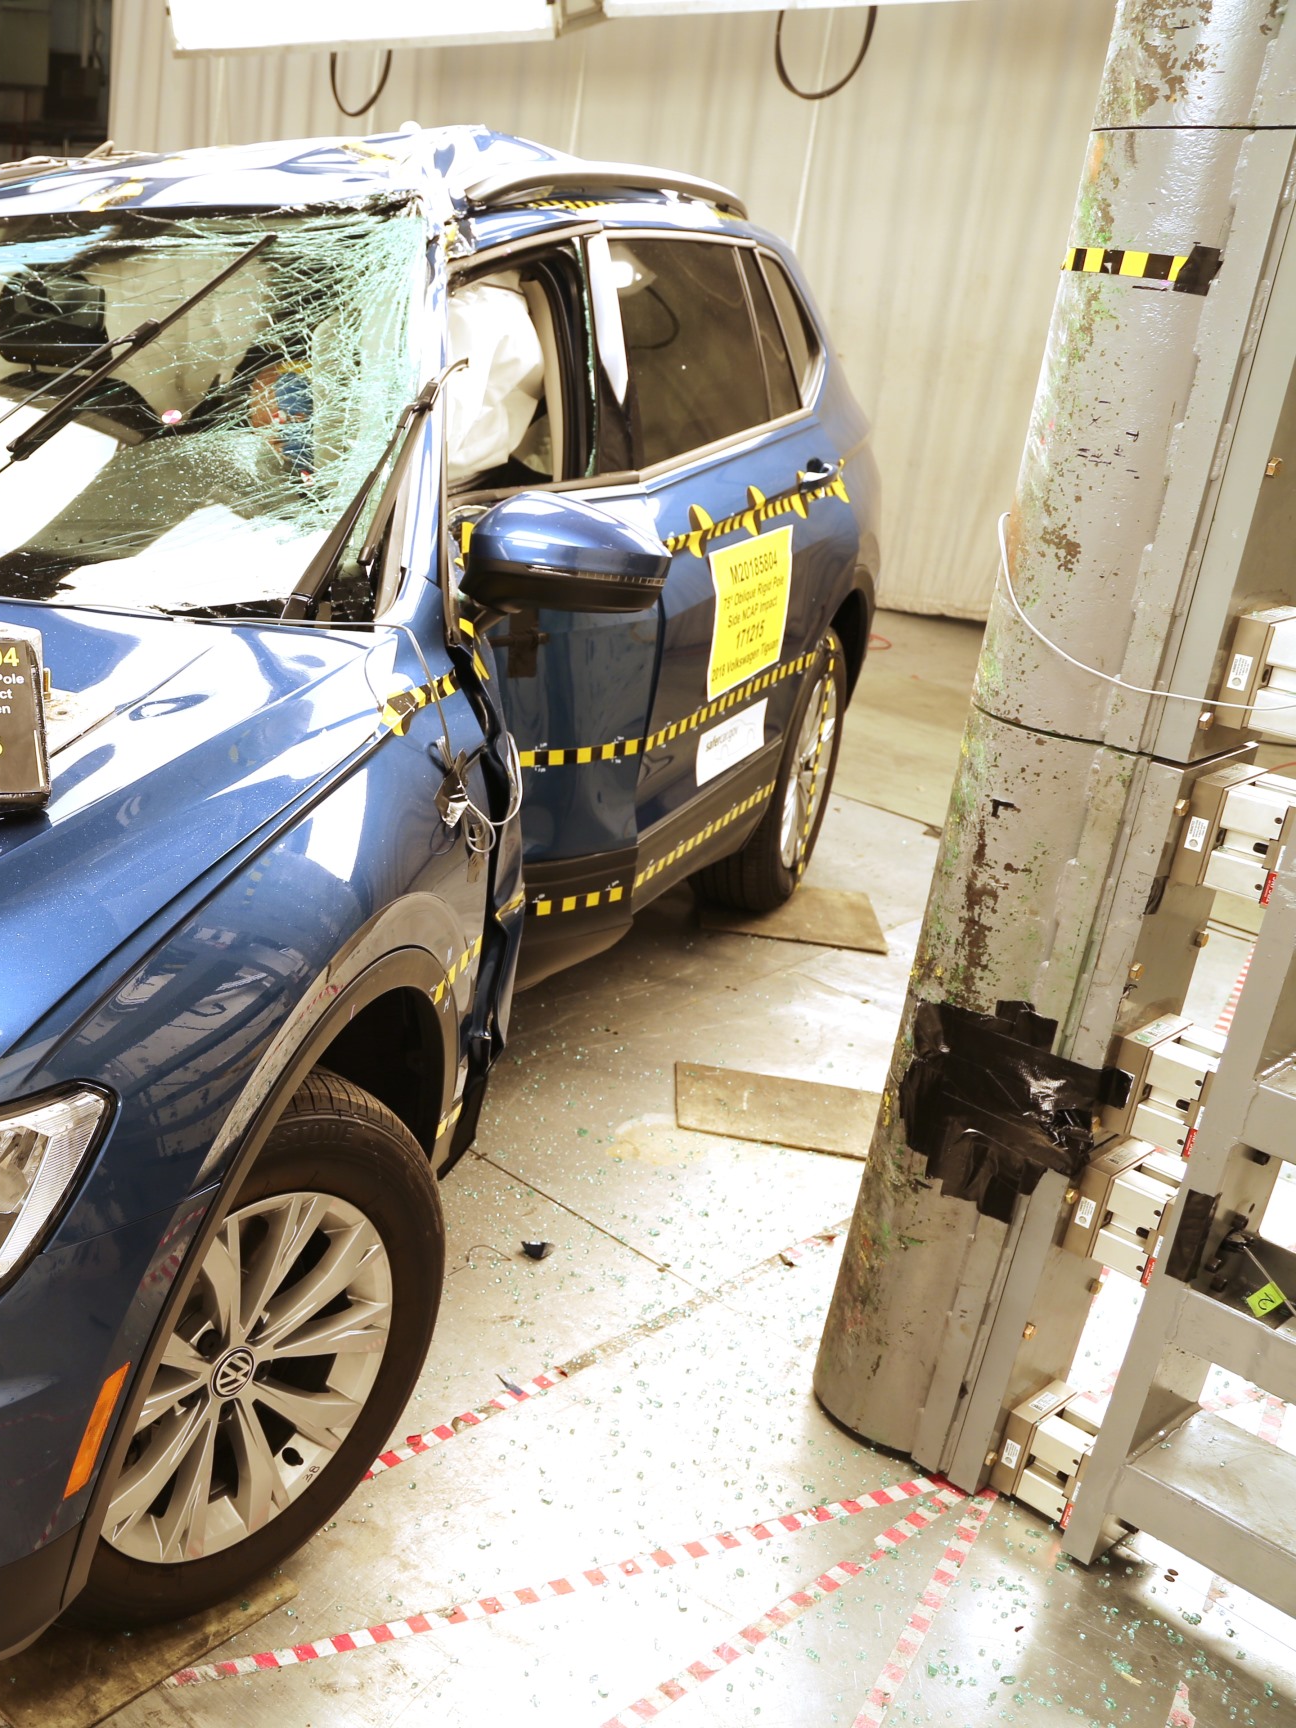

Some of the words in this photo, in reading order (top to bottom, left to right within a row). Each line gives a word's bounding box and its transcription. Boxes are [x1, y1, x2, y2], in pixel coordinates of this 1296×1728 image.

[730, 550, 777, 585] M20185804
[734, 589, 756, 606] Oblique
[758, 580, 772, 596] Rigid
[773, 575, 784, 588] Pole
[728, 615, 740, 629] Side
[742, 602, 759, 620] NCAP
[760, 596, 778, 613] Impact
[736, 619, 765, 649] 171215
[711, 663, 725, 682] 2018
[727, 648, 759, 674] Volkswagen
[761, 638, 779, 657] Tiguan
